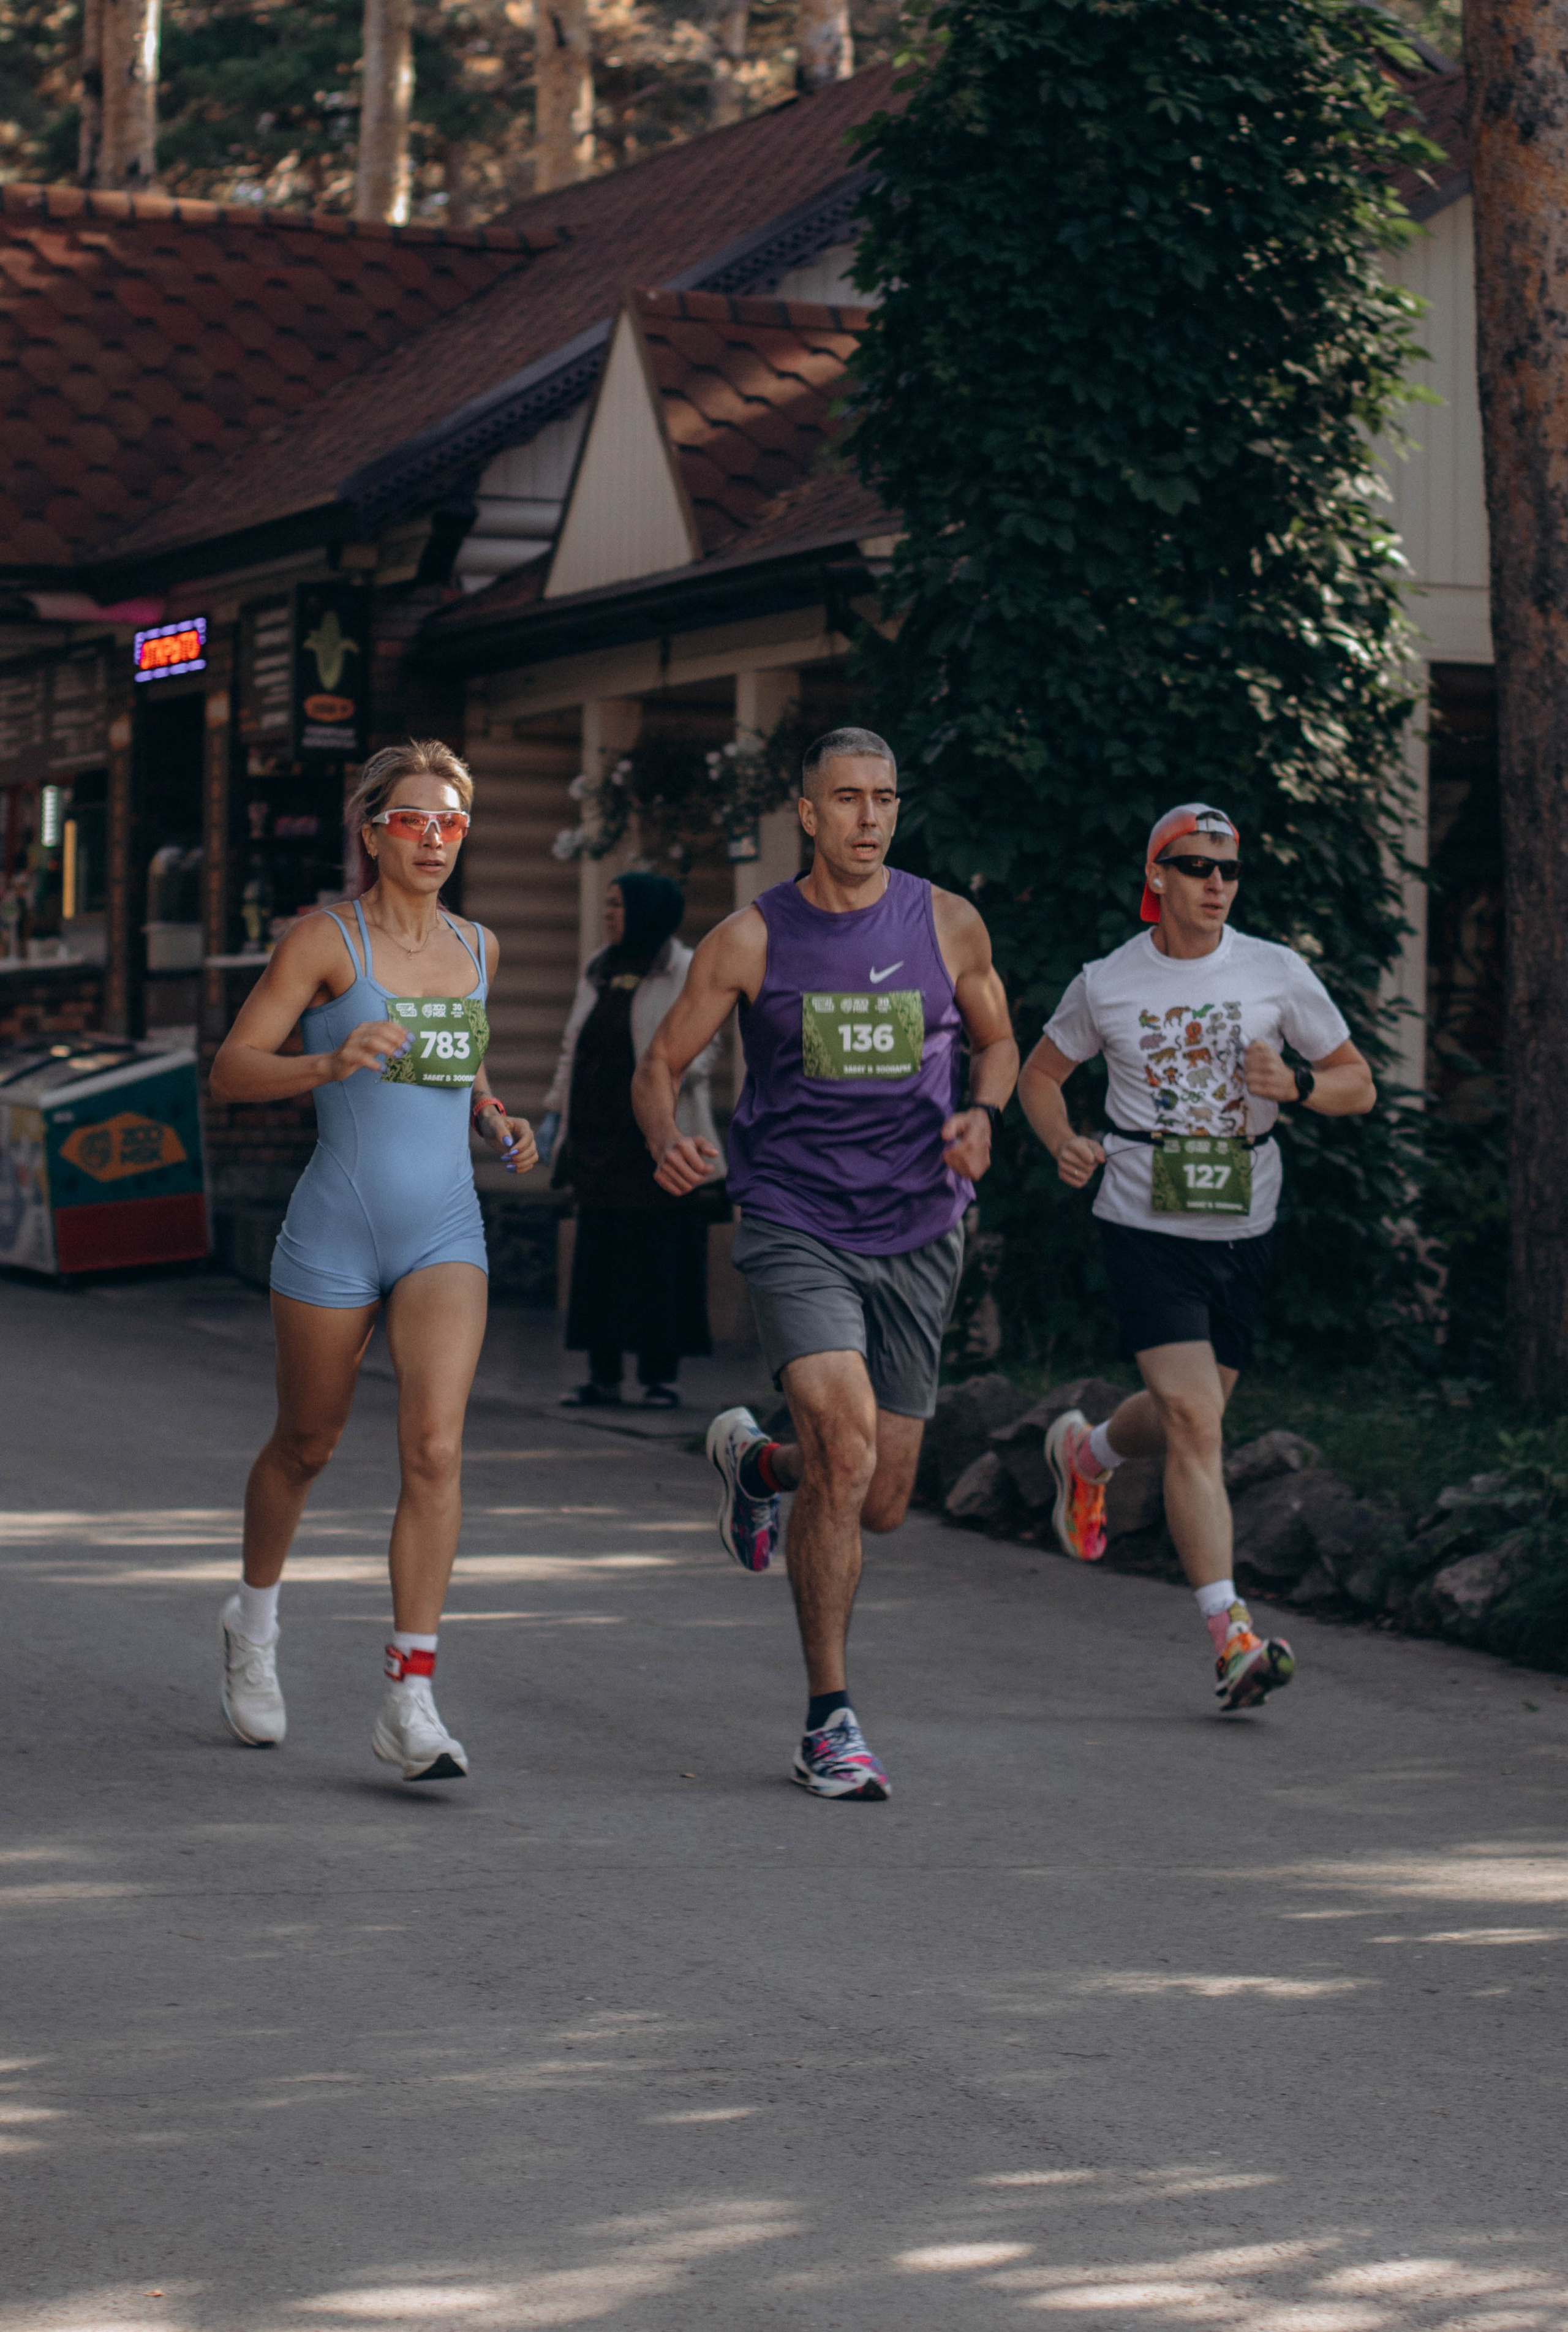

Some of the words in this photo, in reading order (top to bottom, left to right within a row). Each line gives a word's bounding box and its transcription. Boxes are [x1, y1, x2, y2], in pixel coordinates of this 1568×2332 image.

[420, 1031, 470, 1059] 783
[838, 1024, 894, 1052] 136
[1183, 1164, 1231, 1189] 127
